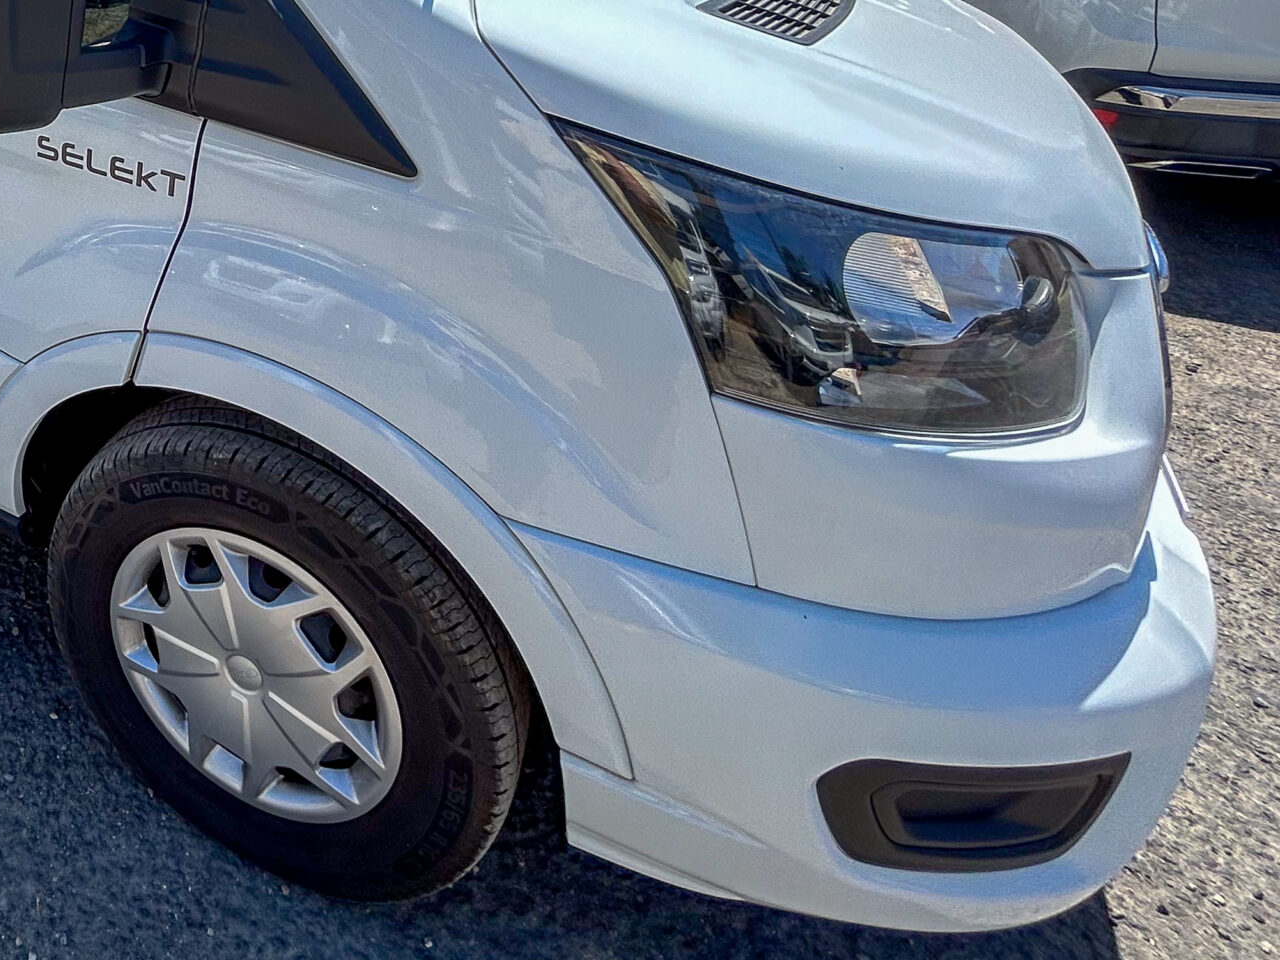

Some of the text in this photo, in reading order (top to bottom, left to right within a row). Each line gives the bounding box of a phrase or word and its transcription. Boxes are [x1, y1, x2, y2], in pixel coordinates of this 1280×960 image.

[37, 135, 186, 197] SELEKT
[129, 477, 270, 515] VanContact Eco
